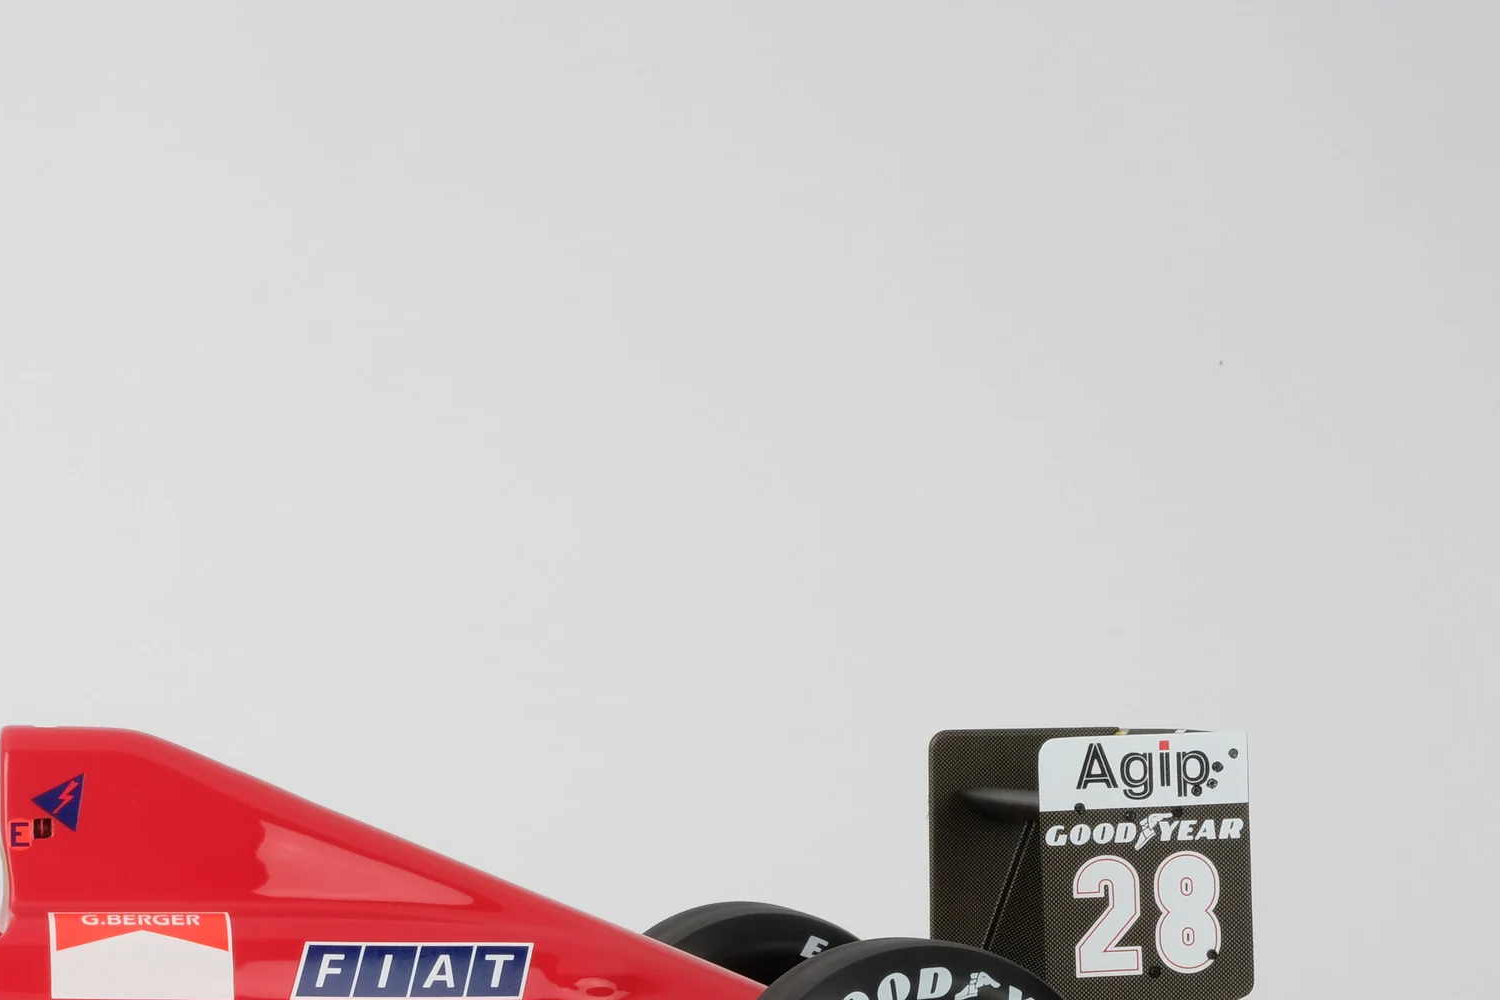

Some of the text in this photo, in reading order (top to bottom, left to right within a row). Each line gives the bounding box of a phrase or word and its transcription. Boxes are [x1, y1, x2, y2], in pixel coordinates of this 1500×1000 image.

[1076, 740, 1211, 800] Agip
[81, 914, 201, 926] G.BERGER
[1072, 849, 1222, 979] 28
[314, 953, 515, 989] FIAT
